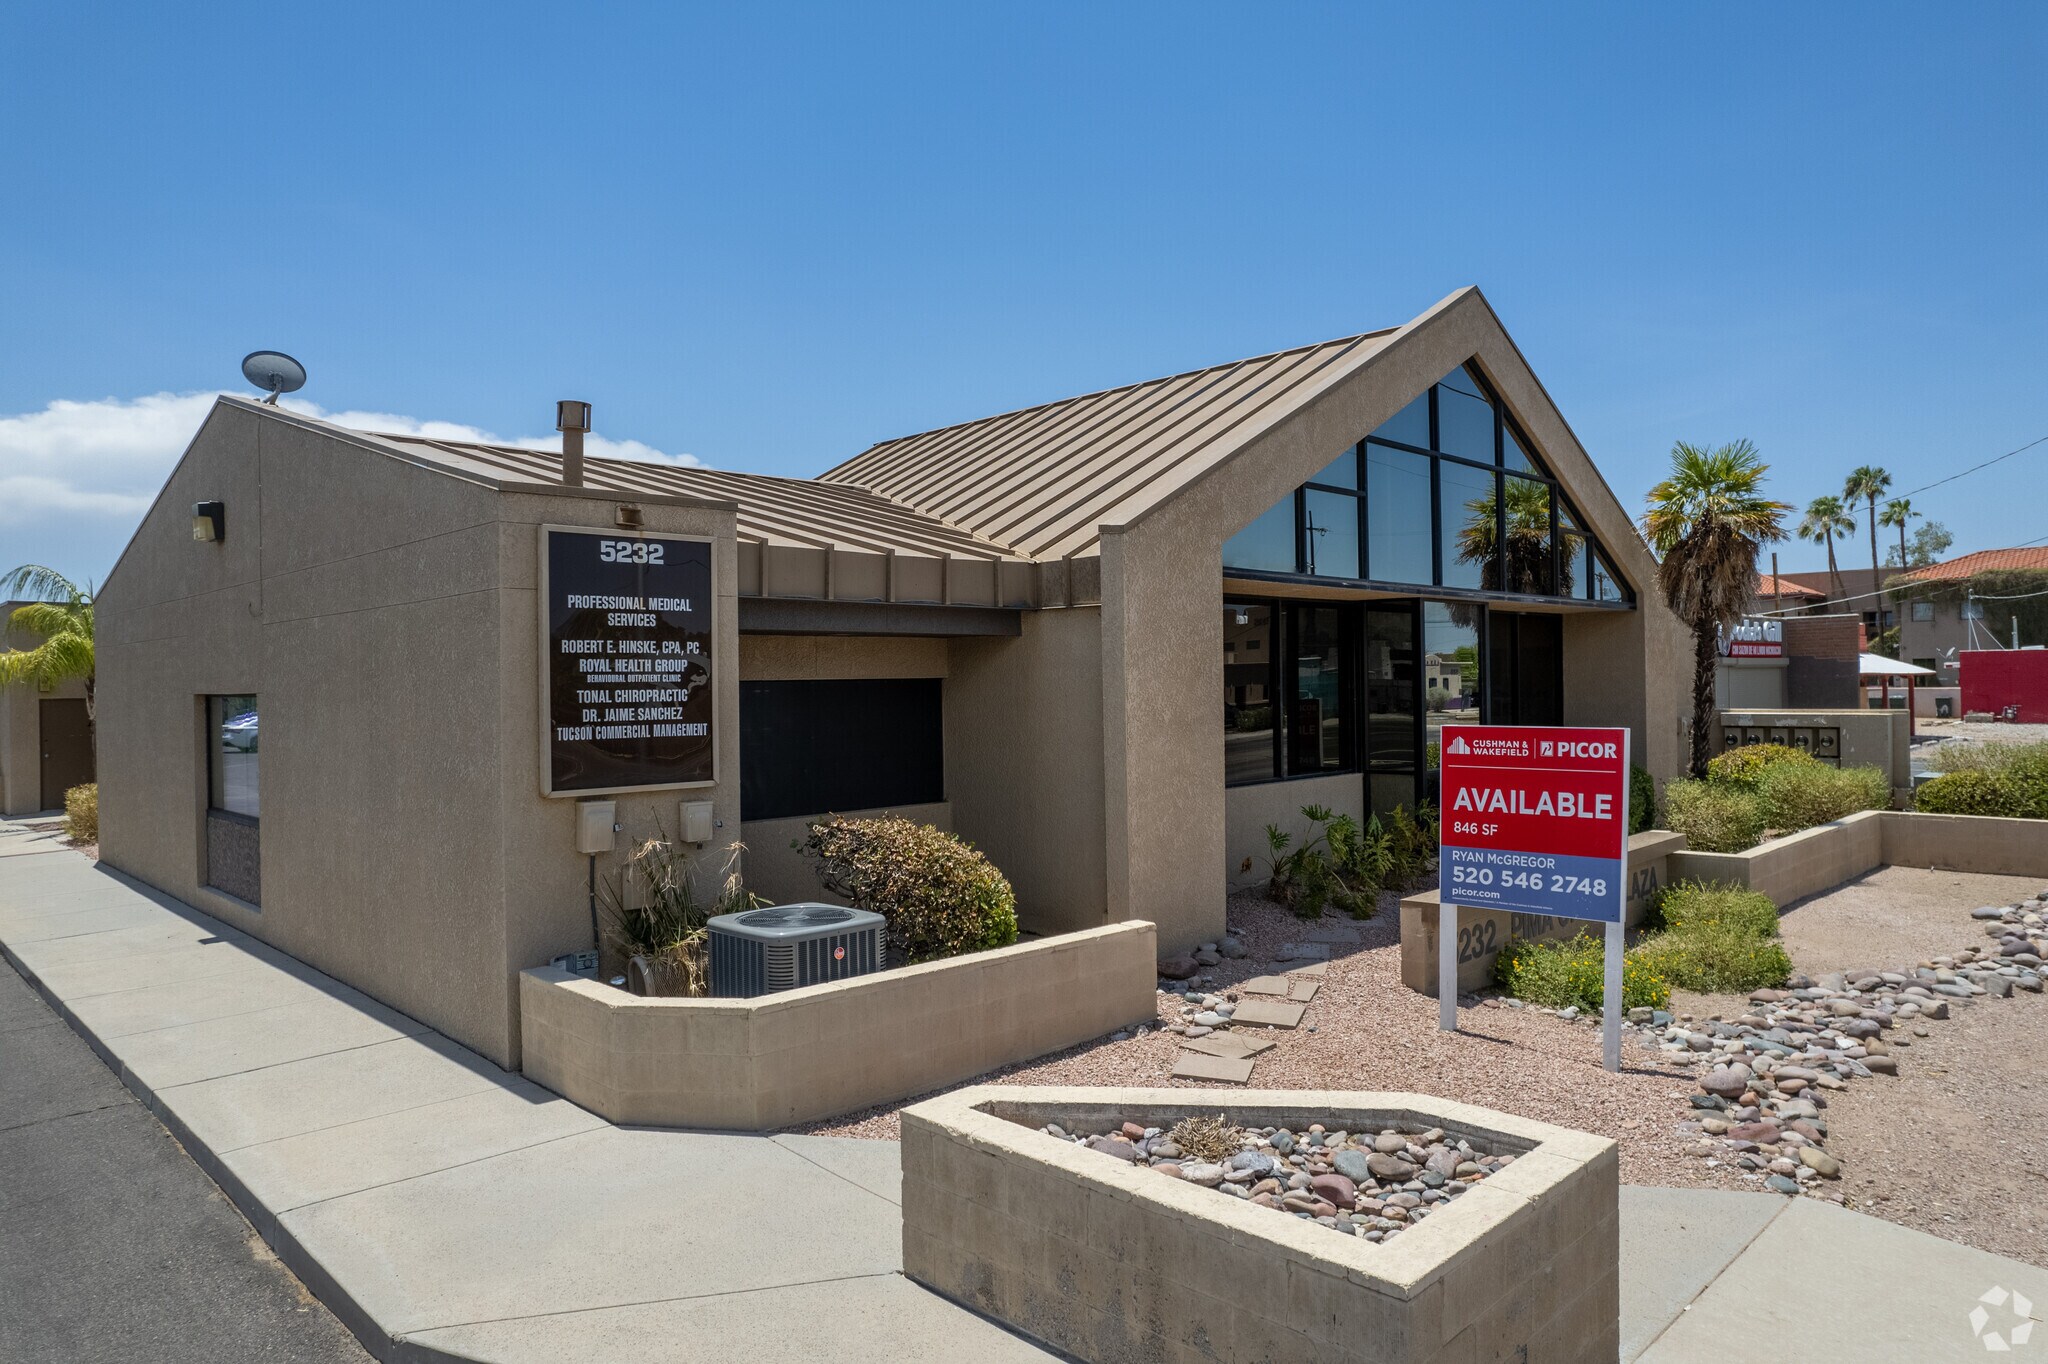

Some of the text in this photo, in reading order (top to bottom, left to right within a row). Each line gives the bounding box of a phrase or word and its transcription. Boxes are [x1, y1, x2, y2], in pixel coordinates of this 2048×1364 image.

[600, 540, 664, 565] 5232
[567, 594, 692, 612] PROFESSIONAL MEDICAL
[607, 613, 656, 627] SERVICES
[561, 639, 699, 656] ROBERT E. HINSKE, CPA, PC
[579, 659, 688, 673] ROYAL HEALTH GROUP
[587, 674, 681, 683] BEHAVIOURAL OUTPATIENT CLINIC
[577, 688, 688, 703] TONAL CHIROPRACTIC
[583, 707, 683, 722] DR. JAIME SANCHEZ
[557, 723, 708, 741] TUCSON COMMERCIAL MANAGEMENT
[1473, 739, 1520, 748] CUSHMAN
[1473, 747, 1529, 756] WAKEFIELD
[1557, 741, 1617, 759] PICOR
[1453, 787, 1612, 820] AVAILABLE
[1453, 821, 1498, 836] 846 SF
[1452, 850, 1555, 869] RYAN McGREGOR
[1452, 866, 1607, 896] 520 546 2748
[1452, 887, 1500, 899] picor.com
[1457, 919, 1497, 965] 232
